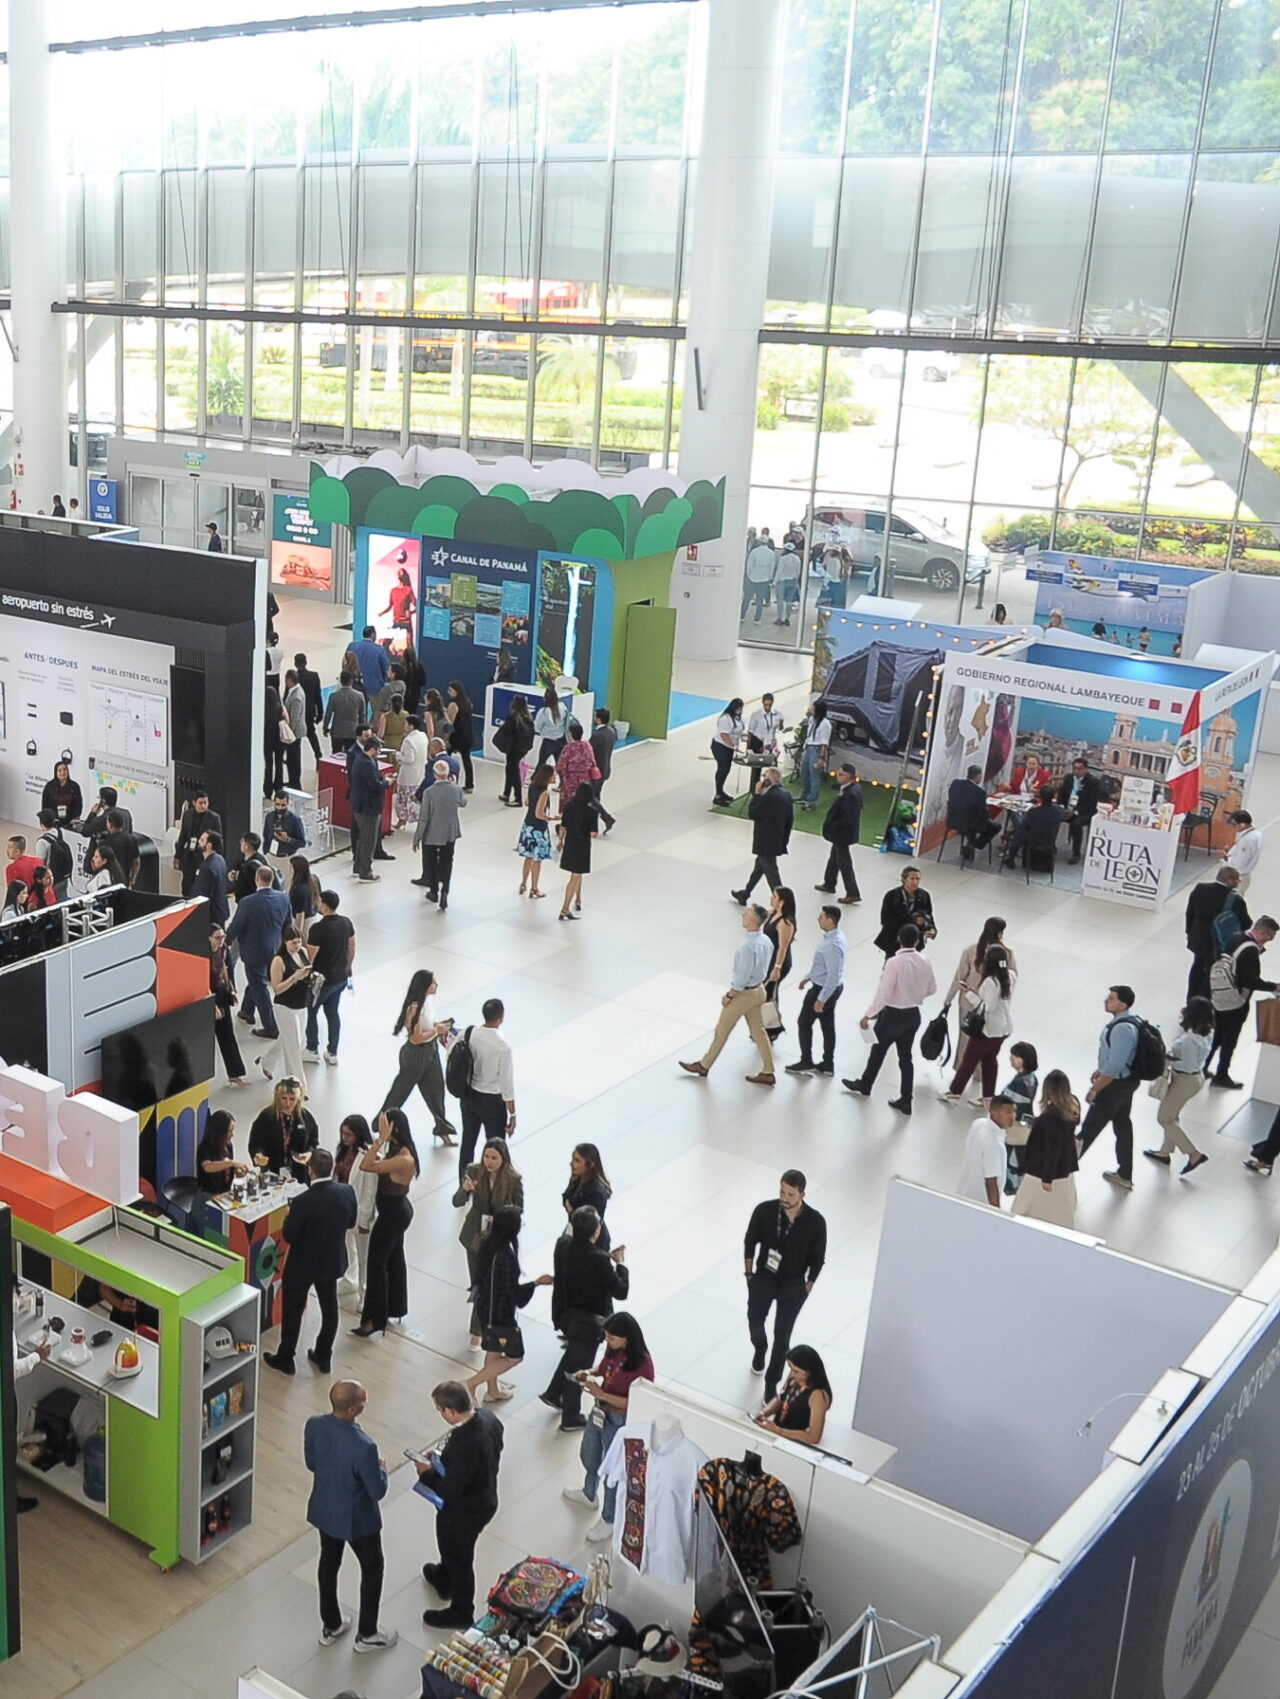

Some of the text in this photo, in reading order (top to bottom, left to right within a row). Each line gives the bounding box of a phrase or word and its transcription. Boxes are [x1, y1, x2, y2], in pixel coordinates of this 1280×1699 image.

[2, 594, 50, 612] aeropuerto
[51, 601, 64, 616] sin
[66, 605, 95, 621] estrés
[108, 668, 118, 676] DEL
[141, 674, 151, 682] DEL
[956, 667, 1011, 684] GOBIERNO
[1014, 676, 1067, 695] REGIONAL
[1070, 686, 1146, 707] LAMBAYEQUE
[1095, 827, 1108, 838] LA
[1089, 836, 1152, 866] RUTA
[1104, 859, 1162, 886] LEÓN
